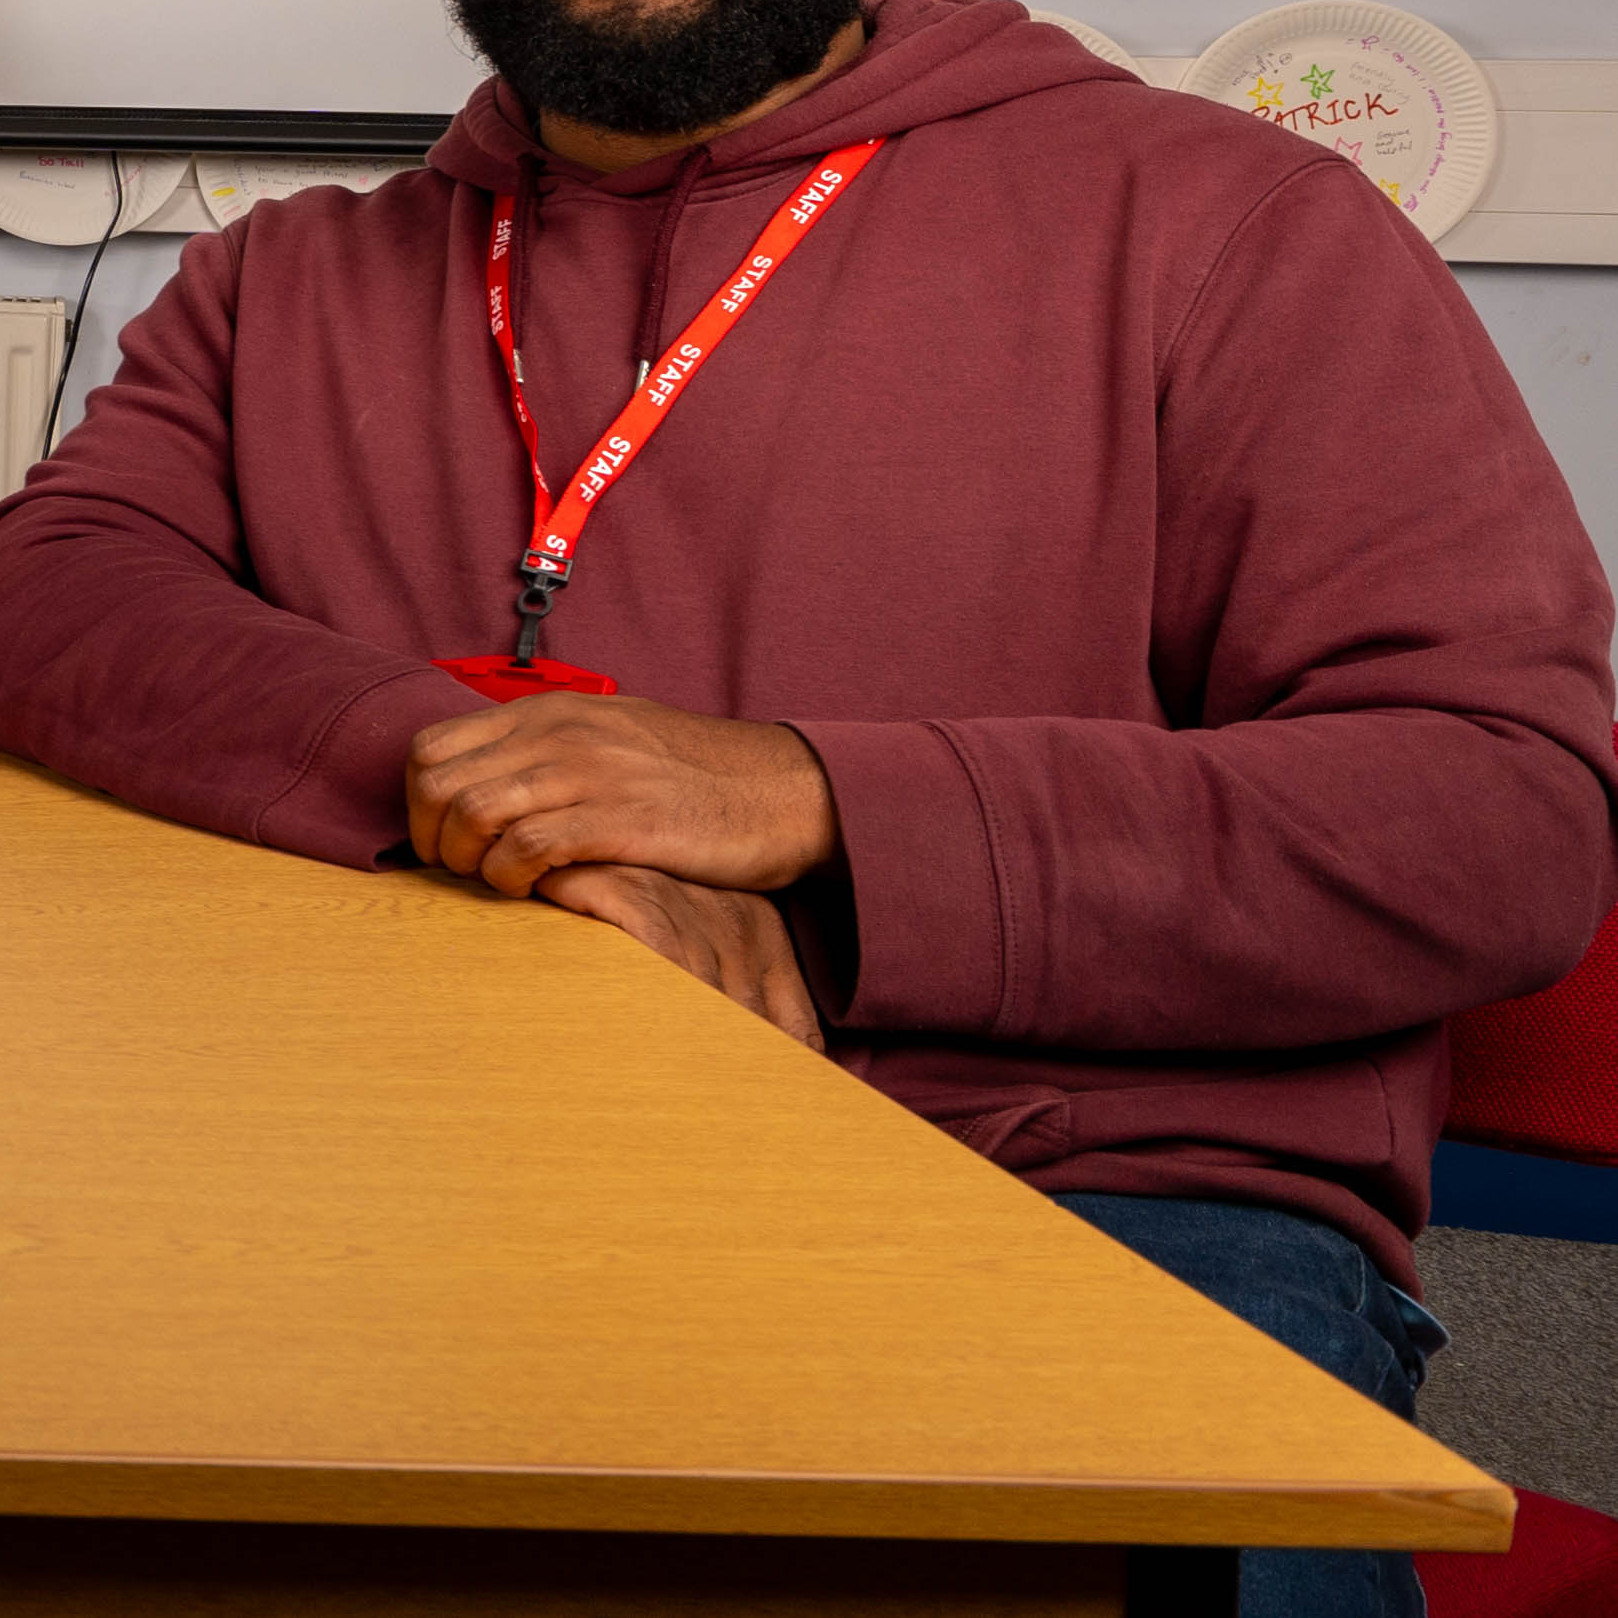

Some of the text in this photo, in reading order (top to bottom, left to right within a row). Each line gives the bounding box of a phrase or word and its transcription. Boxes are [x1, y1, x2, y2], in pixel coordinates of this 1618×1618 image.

[789, 169, 843, 224] STAFF
[492, 218, 513, 261] STAFF
[720, 255, 773, 313] STAFF
[648, 343, 702, 407] STAFF
[579, 435, 632, 503] STAFF
